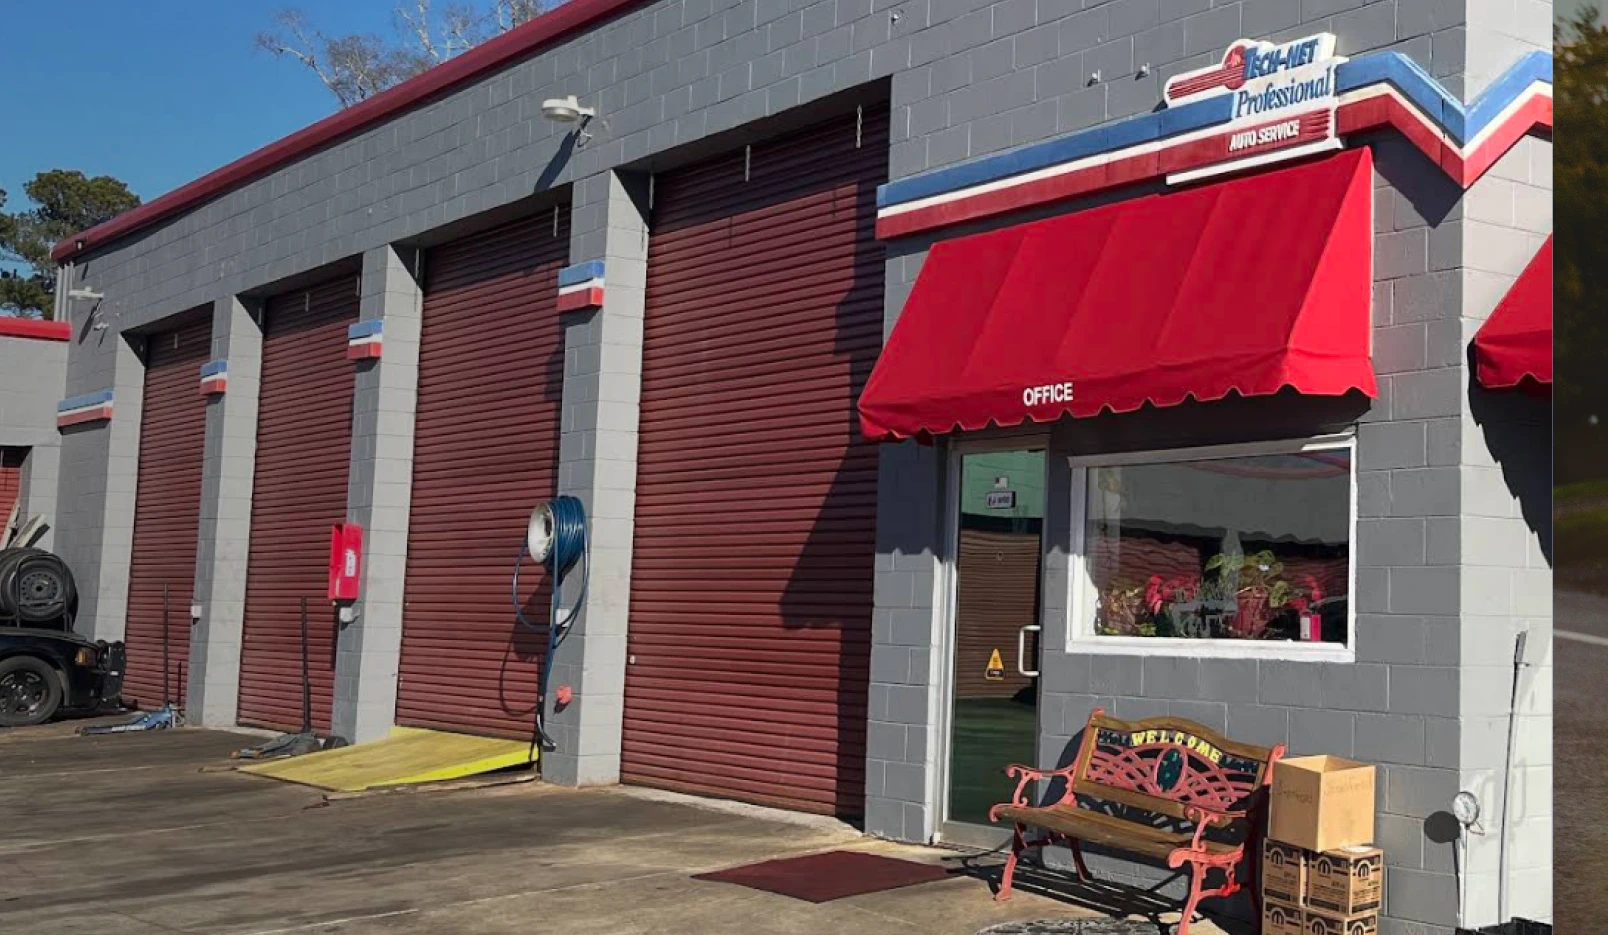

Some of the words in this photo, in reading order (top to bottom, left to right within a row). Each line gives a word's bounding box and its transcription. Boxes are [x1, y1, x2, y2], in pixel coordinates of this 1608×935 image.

[1245, 39, 1319, 79] TECH-NET
[1237, 66, 1331, 118] Professional
[1229, 131, 1257, 152] AUTO
[1257, 119, 1300, 145] SERVICE
[1023, 382, 1074, 407] OFFICE
[1131, 729, 1222, 763] WELCOME
